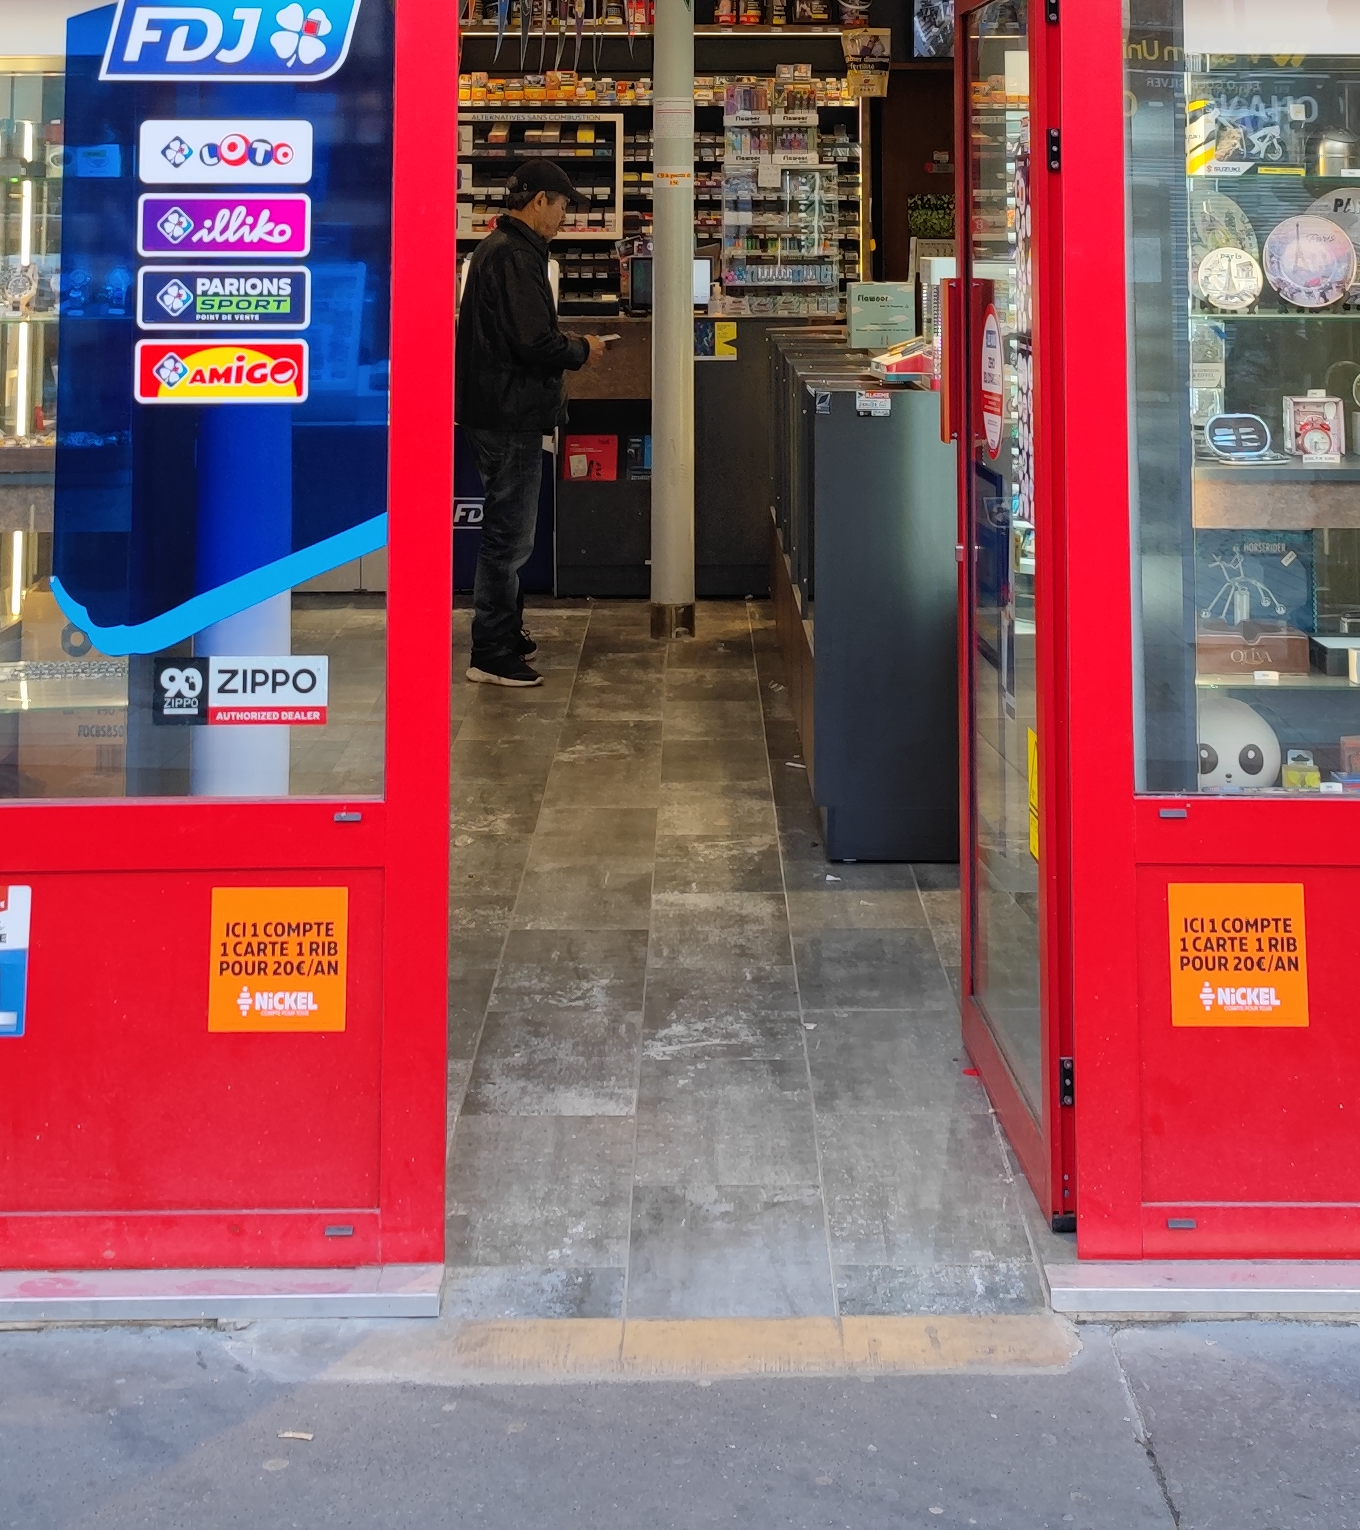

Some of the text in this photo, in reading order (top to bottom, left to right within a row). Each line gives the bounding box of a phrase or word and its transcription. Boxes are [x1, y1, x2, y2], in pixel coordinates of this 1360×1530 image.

[122, 7, 262, 64] FDJ
[199, 131, 296, 168] LOTO
[191, 205, 293, 244] illiko
[1305, 233, 1337, 243] Paris
[195, 277, 292, 296] PARIONS
[199, 299, 288, 311] SPORT
[1243, 542, 1287, 553] HORSERIDER
[160, 667, 203, 698] 90
[217, 668, 317, 695] ZIPPO
[163, 697, 199, 709] ZIPPO
[216, 711, 321, 721] AUTHORIZED DEALER
[225, 922, 334, 938] ICI 1 COMPTE
[1184, 917, 1293, 933] ICI 1 COMPTE
[220, 941, 338, 957] 1 CARTE 1 RIB
[1180, 937, 1298, 952] 1 CARTE 1 RIB
[219, 959, 339, 977] POUR 20€/AN
[1180, 954, 1300, 973] POUR 20€/AN
[254, 991, 318, 1011] NiCKEL
[1217, 987, 1281, 1006] NiCKEL
